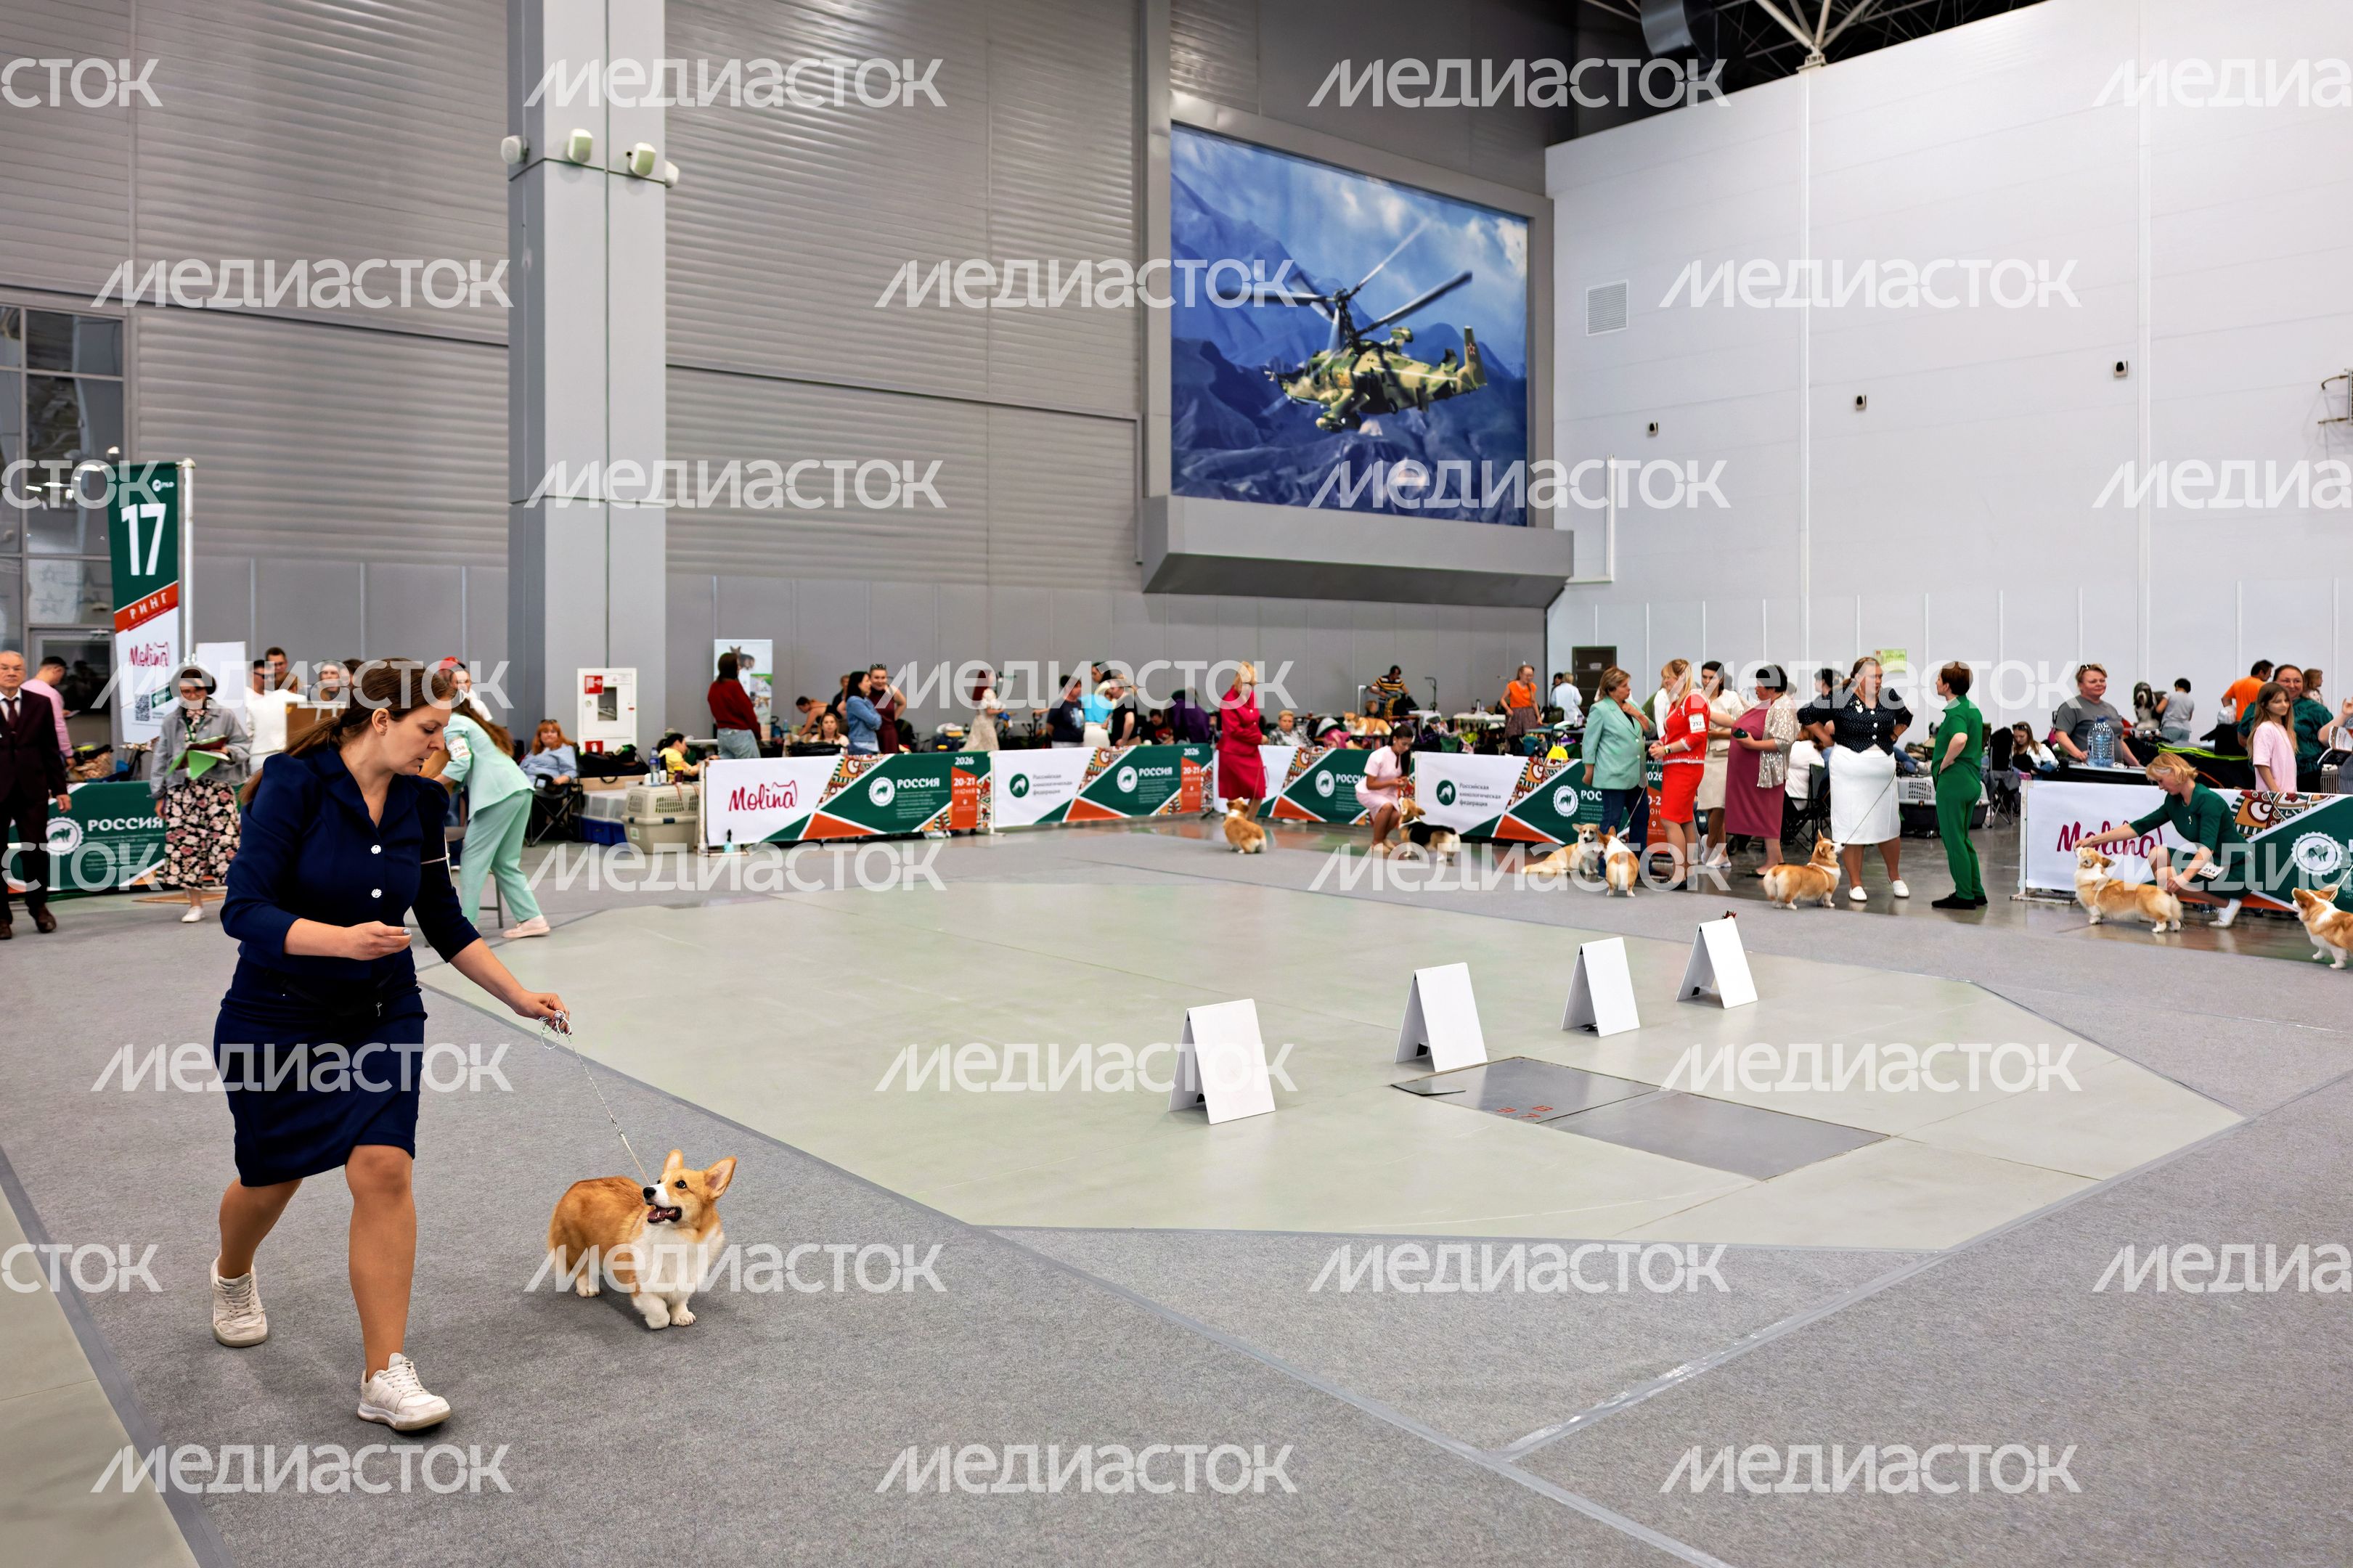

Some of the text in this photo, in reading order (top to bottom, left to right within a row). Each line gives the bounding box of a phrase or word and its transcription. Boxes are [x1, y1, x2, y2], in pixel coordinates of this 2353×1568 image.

[121, 503, 166, 576] 17
[129, 592, 167, 620] РИНГ
[955, 756, 974, 765] 2026
[1138, 767, 1173, 777] РОССИЯ
[1646, 771, 1663, 781] 026
[897, 777, 939, 789] РОССИЯ
[954, 777, 975, 786] 20-21
[729, 780, 797, 812] Molina
[88, 816, 163, 832] РОССИЯ
